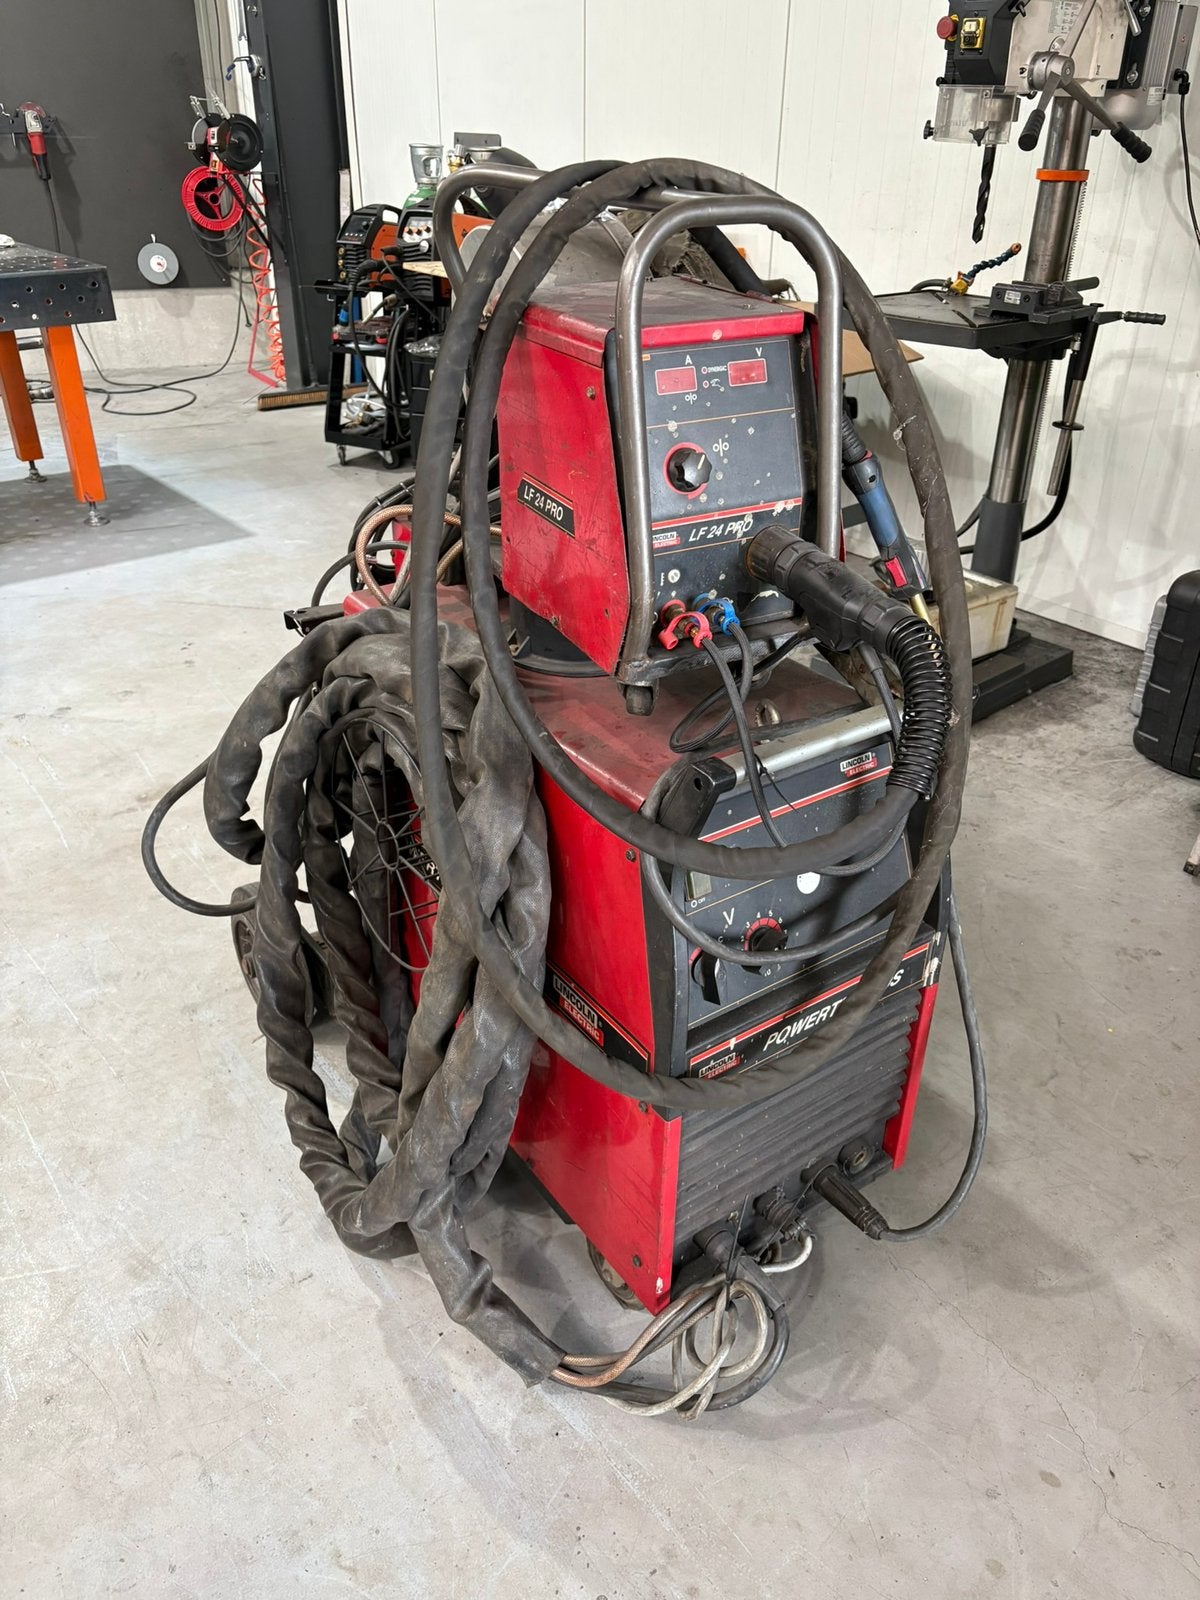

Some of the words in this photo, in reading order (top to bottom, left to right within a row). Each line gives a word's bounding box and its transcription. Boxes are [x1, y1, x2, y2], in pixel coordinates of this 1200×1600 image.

[685, 354, 693, 365] A
[755, 347, 762, 357] V
[523, 485, 535, 501] LF
[534, 493, 545, 509] 24
[545, 499, 563, 521] PRO
[688, 526, 708, 542] LF
[707, 523, 724, 539] 24
[724, 519, 753, 535] PRO
[842, 754, 870, 770] LINCOLN
[850, 761, 875, 775] ELECTRIC
[722, 907, 735, 926] V
[768, 909, 773, 917] 5
[554, 977, 596, 1024] LINCOLN
[564, 1001, 600, 1040] ELECTRIC
[763, 995, 847, 1051] POWERT
[701, 1055, 734, 1076] LINCOLN
[707, 1060, 737, 1079] ELECTRIC
